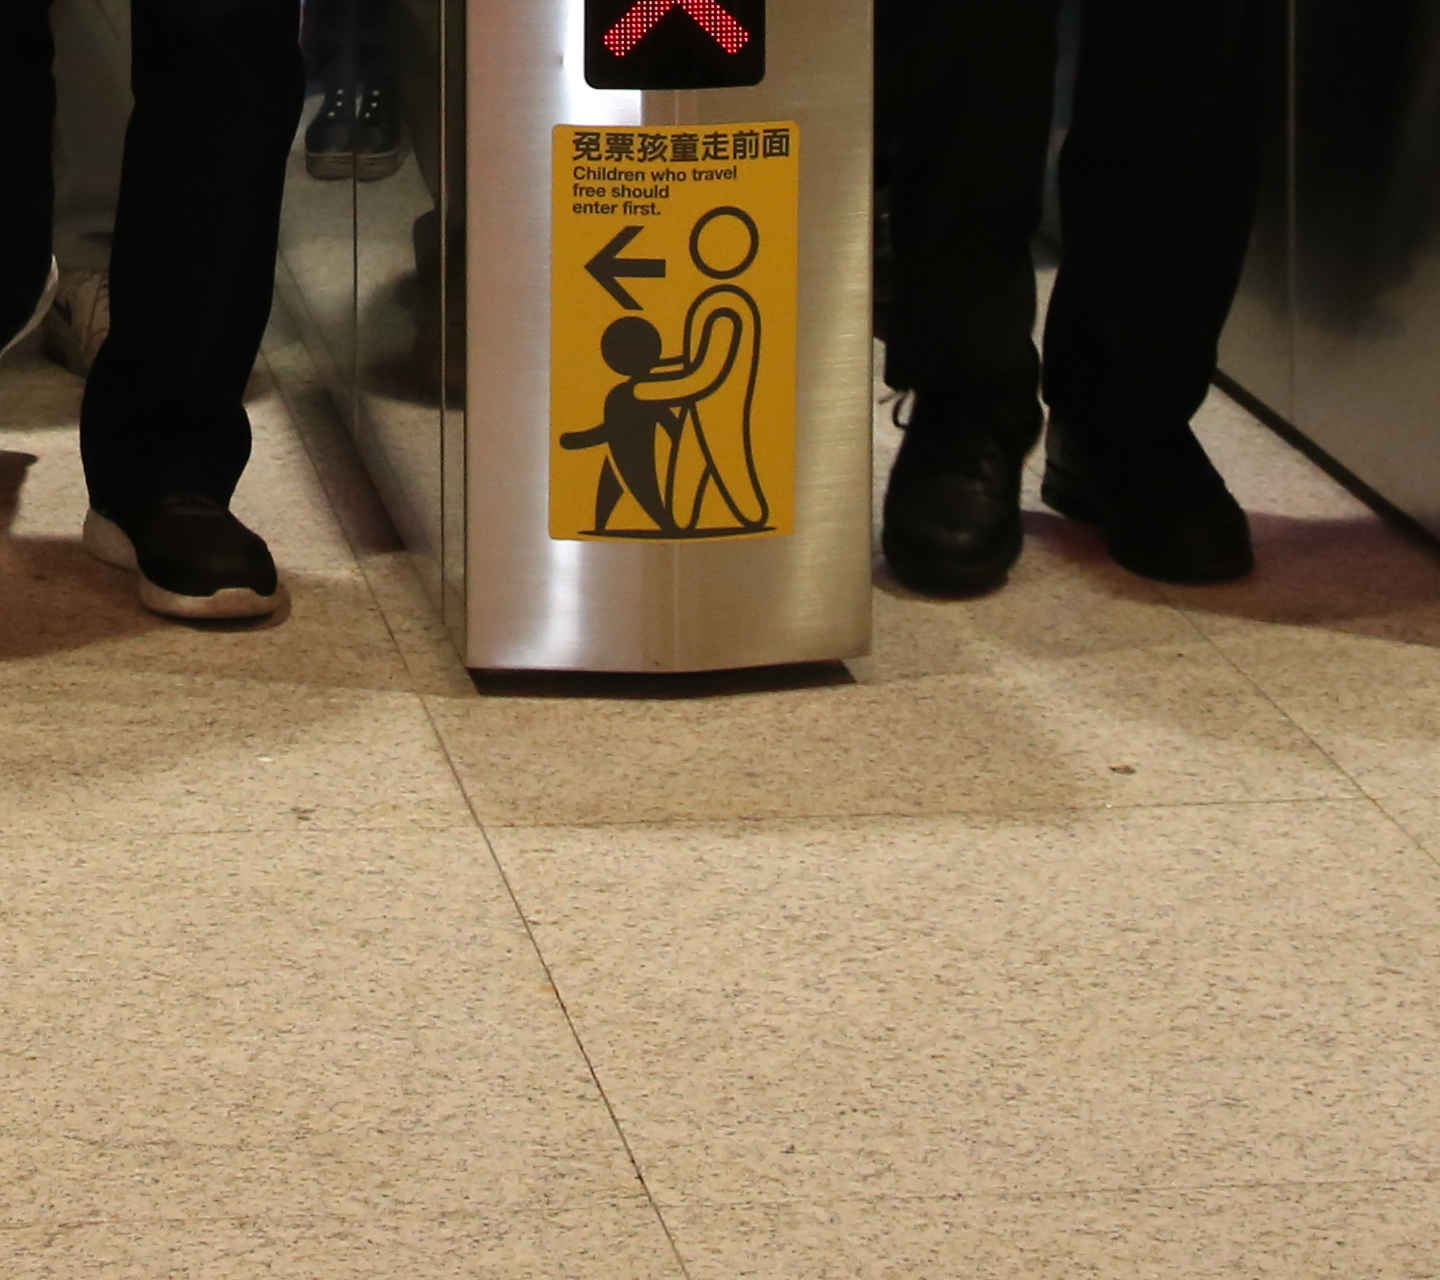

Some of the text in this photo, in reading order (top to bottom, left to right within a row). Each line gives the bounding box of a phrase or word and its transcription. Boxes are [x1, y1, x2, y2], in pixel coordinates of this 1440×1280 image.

[571, 128, 790, 163] 免票孩童走前面
[573, 165, 737, 182] Children who travel
[572, 183, 670, 199] free should
[572, 200, 662, 216] enter first.
